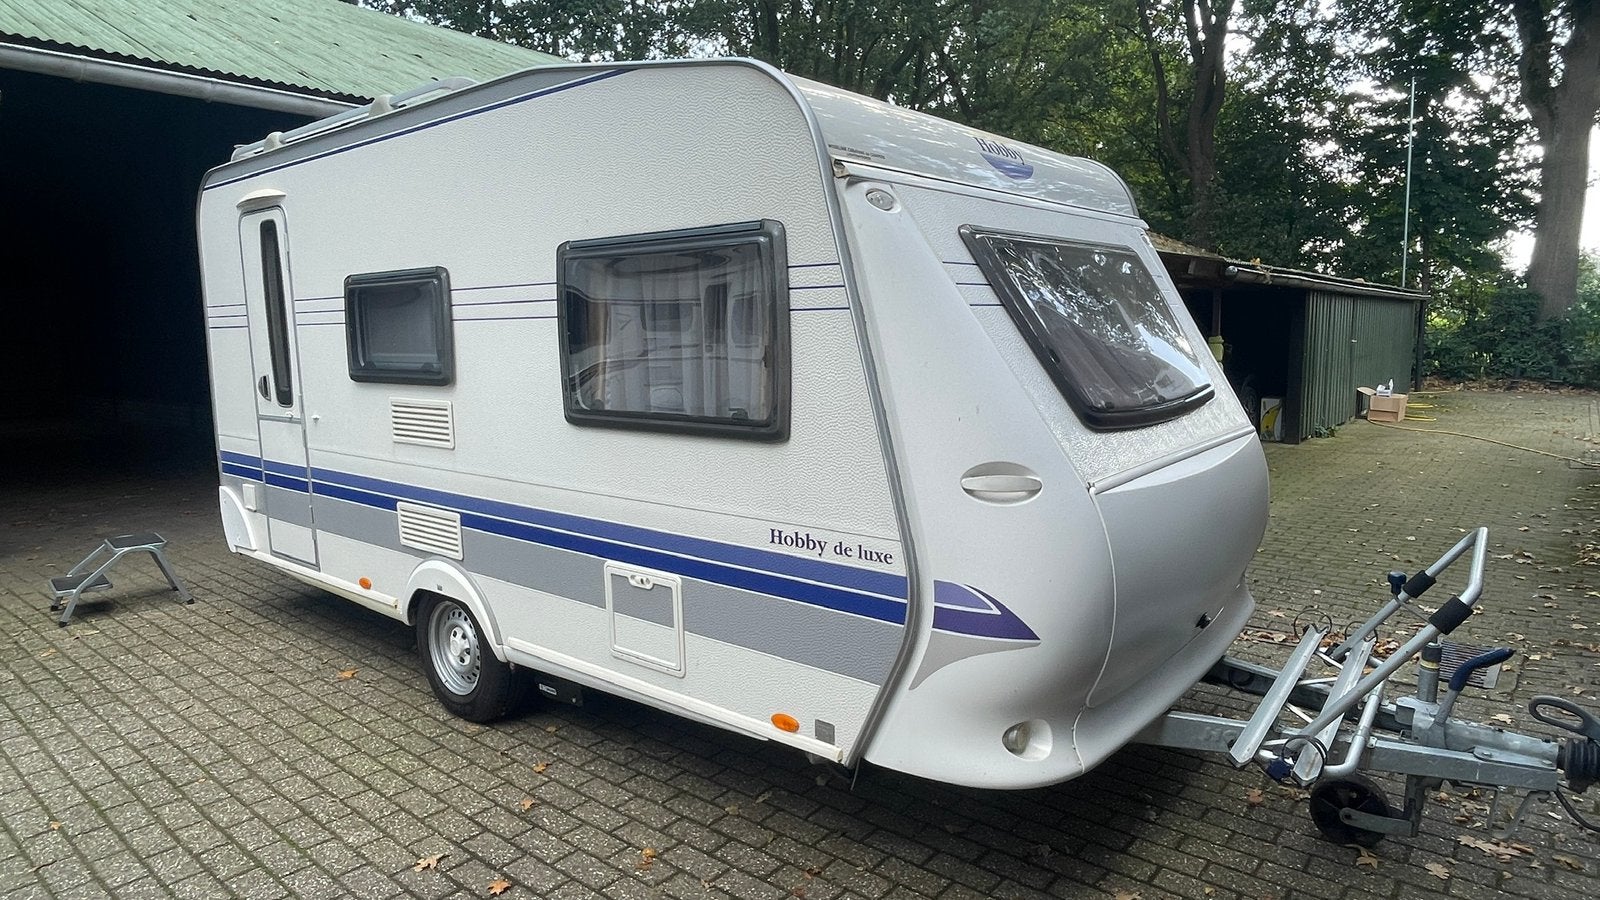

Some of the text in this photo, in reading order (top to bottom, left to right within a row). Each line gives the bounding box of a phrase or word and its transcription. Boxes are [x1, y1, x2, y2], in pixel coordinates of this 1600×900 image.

[973, 136, 1025, 166] Hobby
[769, 528, 894, 565] Hobby de luxe
